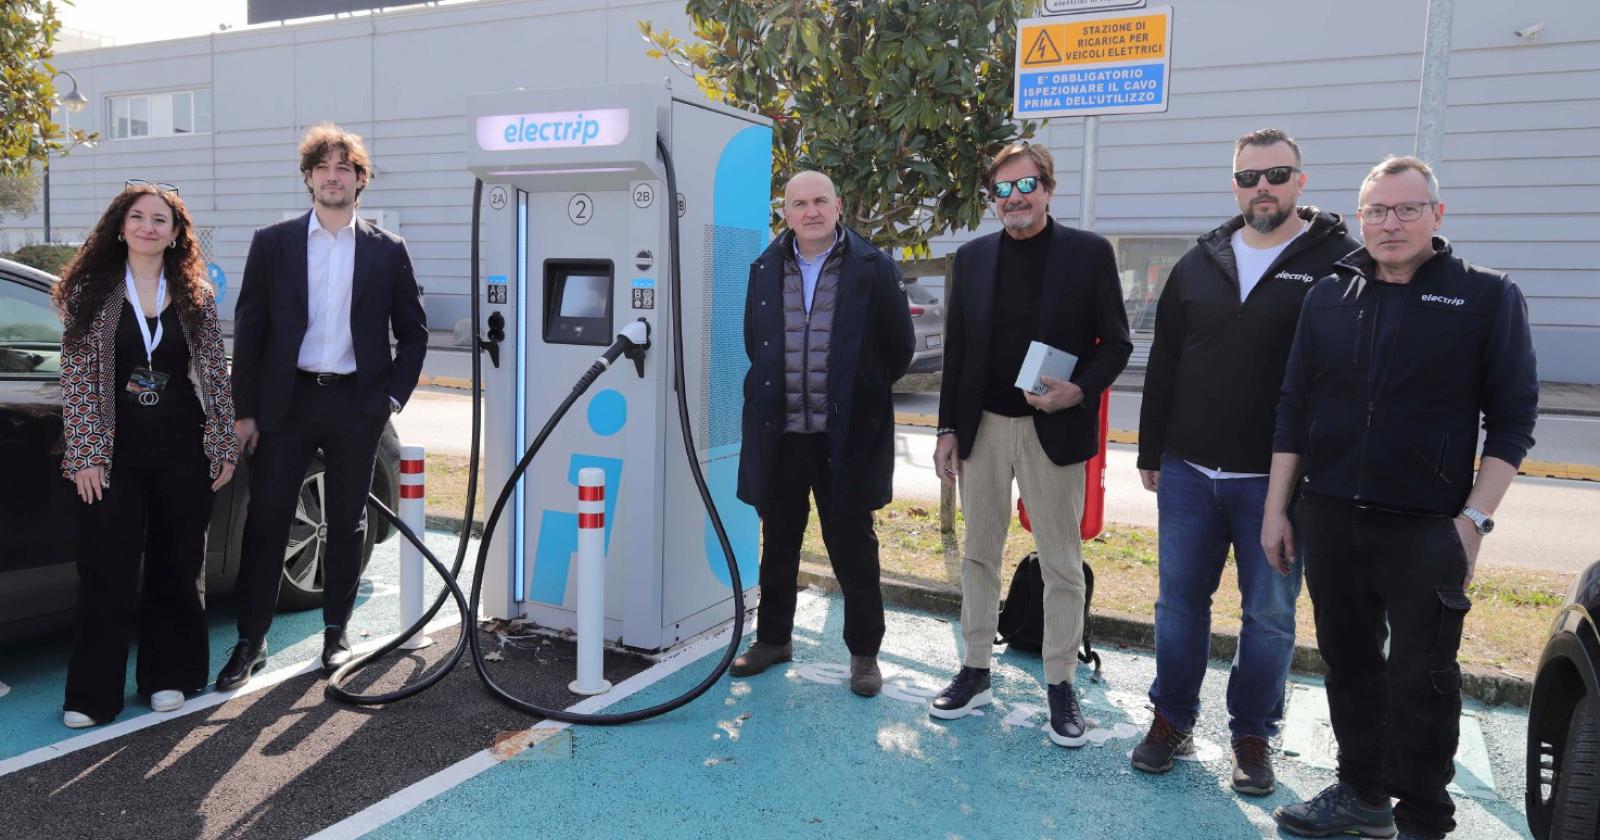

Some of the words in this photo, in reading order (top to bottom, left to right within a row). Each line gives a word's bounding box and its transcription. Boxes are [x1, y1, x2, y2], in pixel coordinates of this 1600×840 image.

[1082, 23, 1132, 36] STAZIONE
[1135, 21, 1146, 30] DI
[1077, 35, 1125, 48] RICARICA
[1129, 33, 1149, 43] PER
[1065, 49, 1105, 60] VEICOLI
[1108, 44, 1162, 57] ELETTRICI
[1037, 75, 1049, 85] E'
[1052, 68, 1143, 84] OBBLIGATORIO
[1024, 83, 1104, 97] ISPEZIONARE
[1108, 81, 1119, 92] IL
[1124, 79, 1157, 91] CAVO
[1024, 96, 1062, 109] PRIMA
[1065, 91, 1156, 106] DELL'UTILIZZO
[503, 112, 600, 145] electrip
[491, 193, 505, 205] 2A
[636, 191, 650, 203] 2B
[575, 200, 586, 219] 2
[634, 289, 642, 298] B
[1421, 294, 1465, 307] electrip
